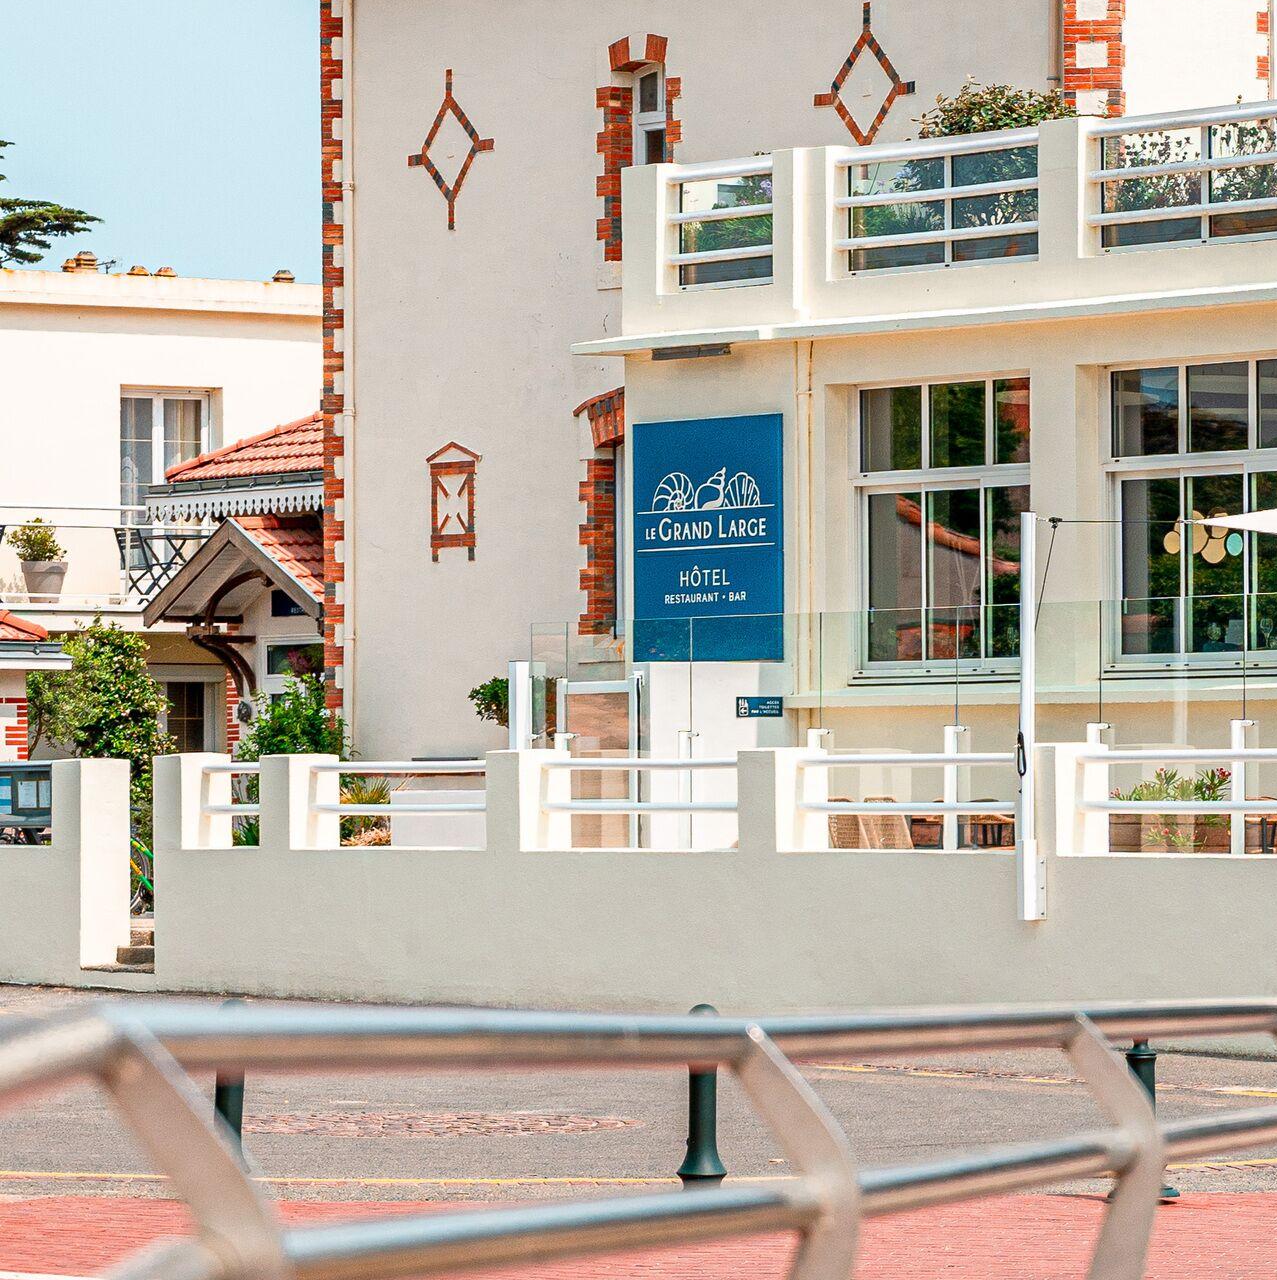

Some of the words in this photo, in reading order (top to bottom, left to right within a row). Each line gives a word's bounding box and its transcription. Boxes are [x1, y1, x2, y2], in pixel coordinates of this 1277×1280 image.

[645, 527, 656, 540] LE
[659, 517, 712, 541] GRAND
[718, 515, 767, 538] LARGE
[679, 565, 730, 587] HÔTEL
[664, 592, 719, 604] RESTAURANT
[728, 591, 747, 602] BAR
